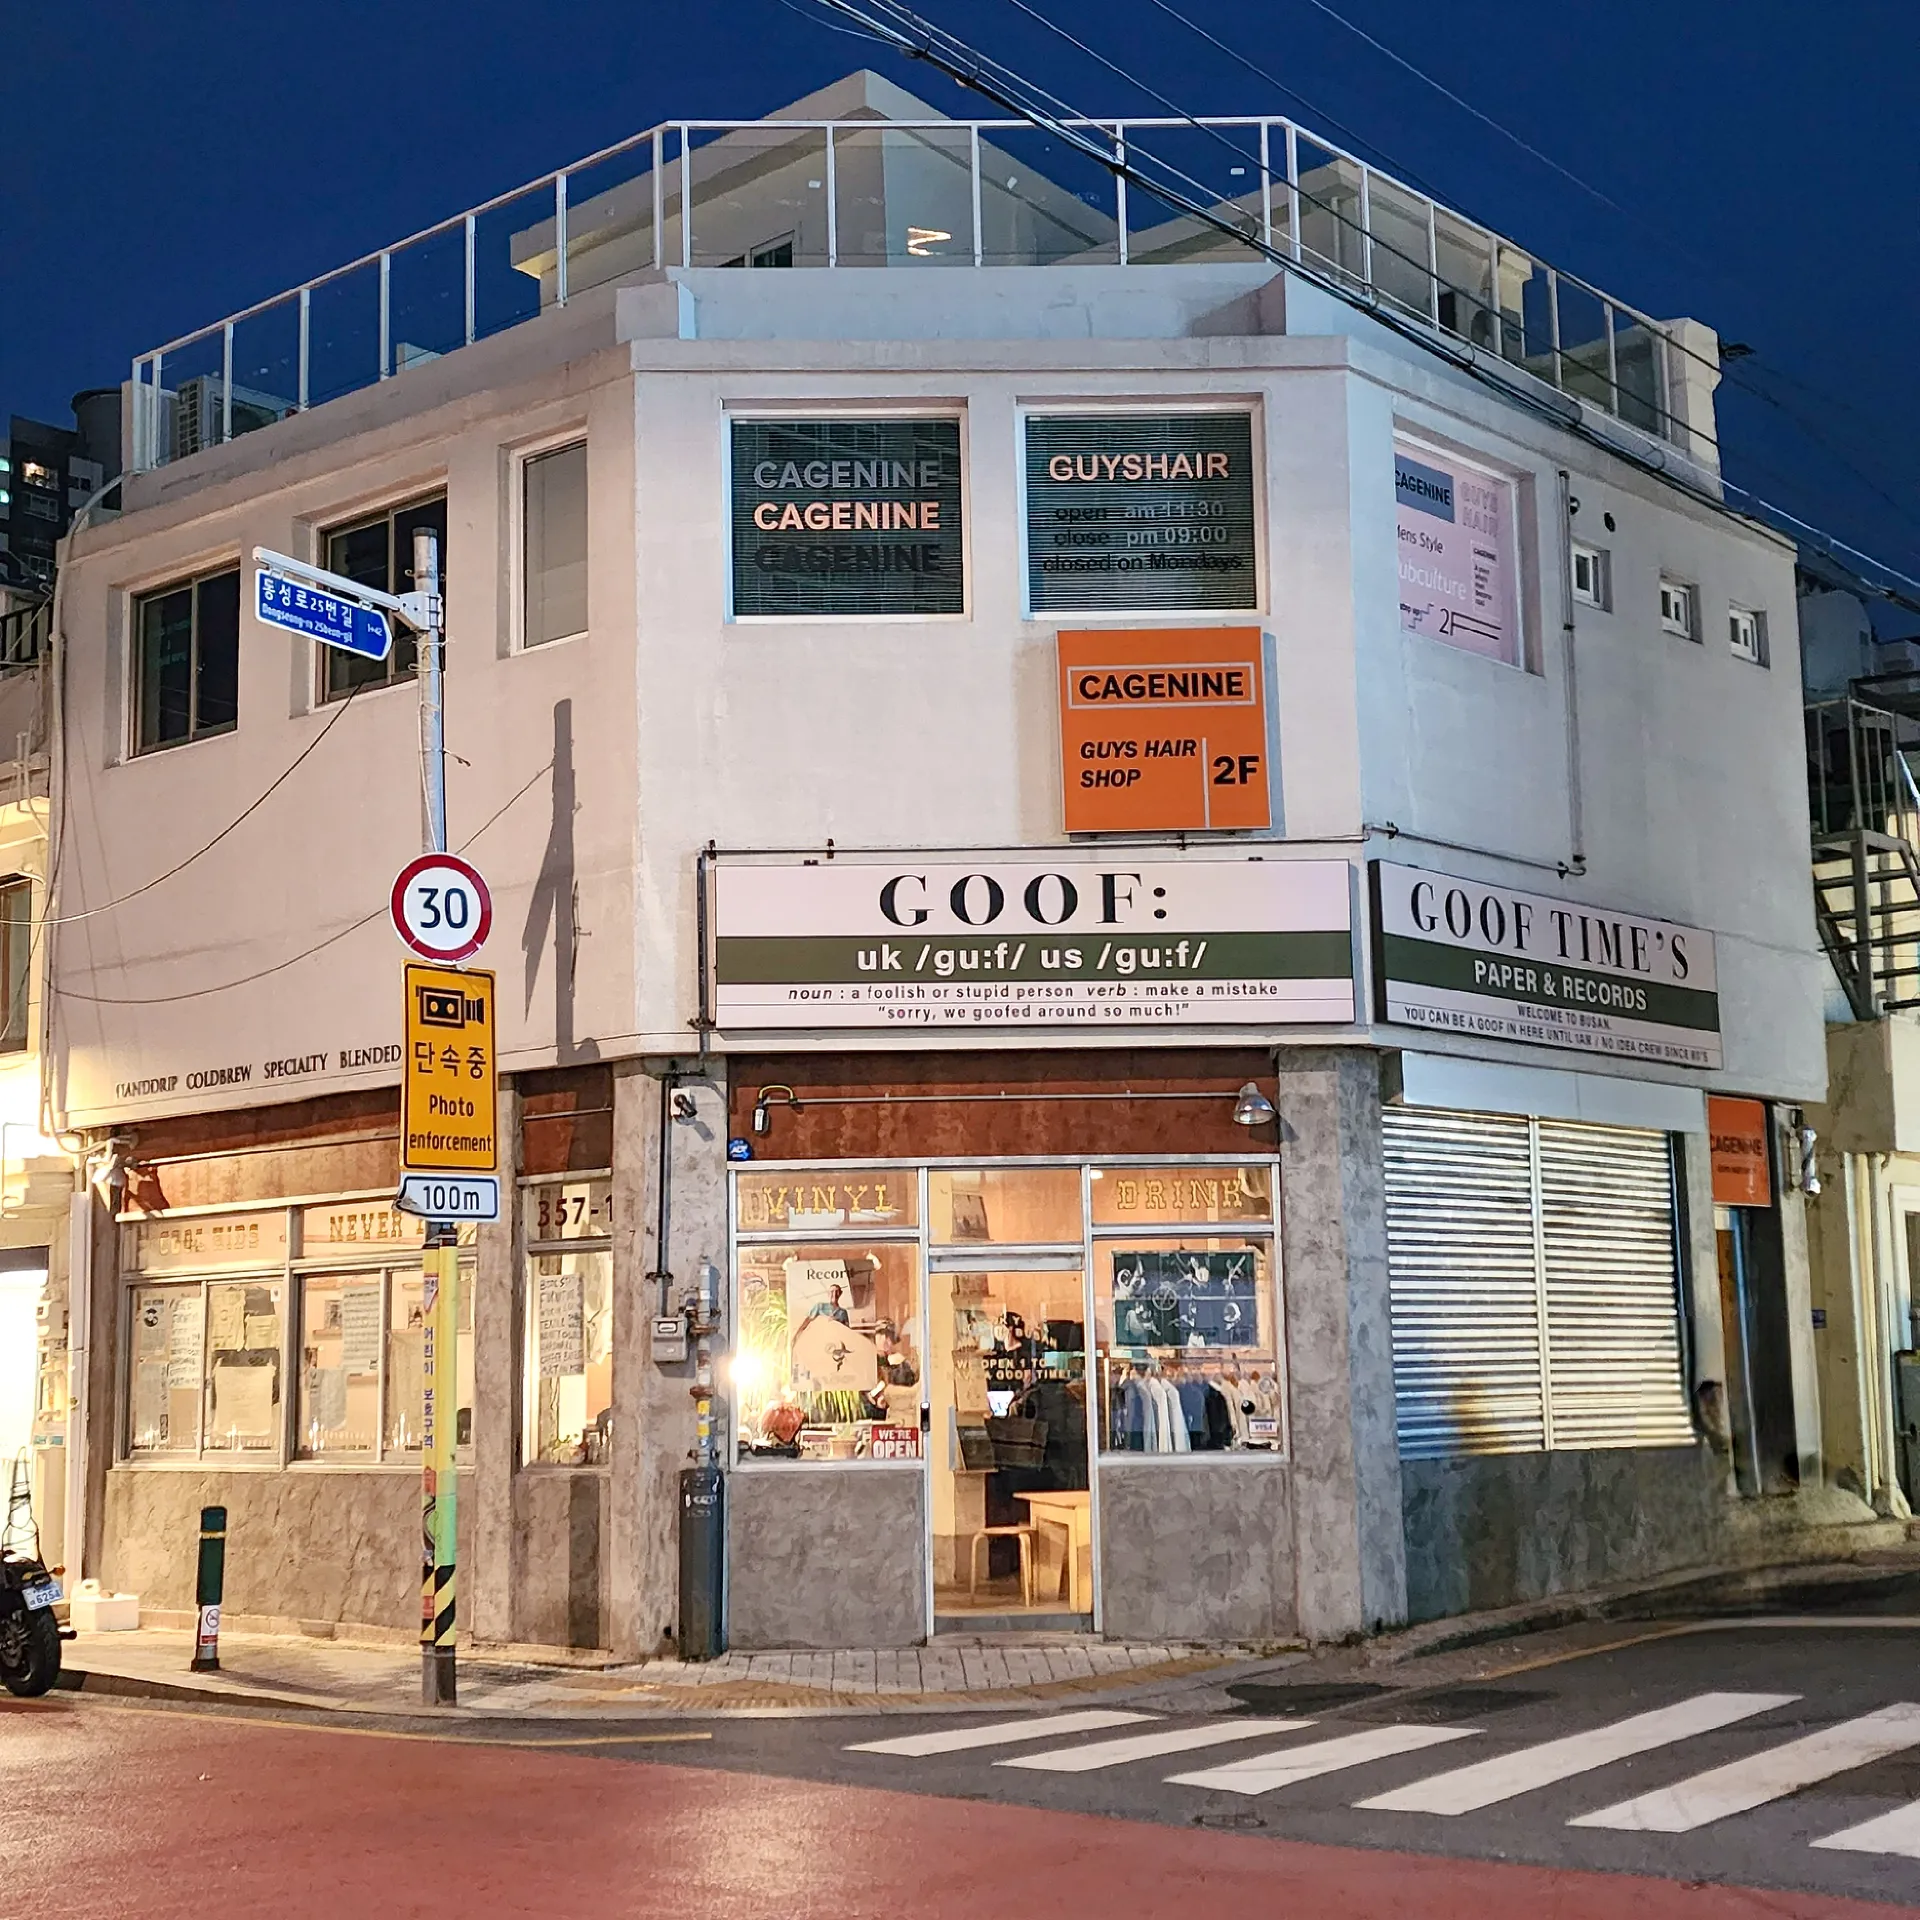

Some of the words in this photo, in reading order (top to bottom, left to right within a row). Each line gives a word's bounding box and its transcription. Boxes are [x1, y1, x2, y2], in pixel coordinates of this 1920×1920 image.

[753, 460, 940, 489] CAGENINE
[1049, 452, 1229, 481] GUYSHAIR
[753, 502, 940, 530] CAGENINE
[1055, 505, 1107, 524] open
[1054, 530, 1110, 546] close
[1126, 530, 1158, 548] pm
[1165, 526, 1227, 544] 09:00
[1420, 532, 1443, 553] Style
[754, 544, 941, 572] CAGENINE
[1043, 554, 1111, 571] closed
[1118, 556, 1143, 571] on
[1150, 552, 1243, 573] Mondays
[1399, 559, 1466, 600] ubculture
[262, 578, 353, 629] 동성로25번길
[1079, 672, 1244, 700] CAGENINE
[1080, 741, 1138, 759] GUYS
[1144, 739, 1197, 757] HAIR
[1080, 769, 1141, 788] SHOP
[1213, 755, 1260, 785] 2F
[418, 887, 469, 929] 30
[879, 873, 1168, 927] GOOF:
[1411, 881, 1534, 951] GOOF
[1551, 910, 1689, 980] TIME'S
[857, 942, 902, 970] uk
[1041, 943, 1083, 969] us
[788, 988, 832, 999] noun
[851, 989, 860, 999] a
[868, 985, 925, 998] foolish
[932, 989, 949, 998] or
[956, 984, 1009, 1001] stupid
[1017, 986, 1073, 1000] person
[1087, 983, 1127, 996] verb
[1146, 983, 1189, 996] make
[1196, 986, 1204, 996] a
[1212, 982, 1278, 996] mistake
[1474, 959, 1538, 993] PAPER
[1543, 971, 1557, 997] &
[1562, 978, 1648, 1011] RECORDS
[944, 1008, 966, 1018] we
[973, 1005, 1031, 1021] goofed
[1038, 1005, 1096, 1017] around
[1104, 1007, 1122, 1017] so
[1517, 1004, 1562, 1024] WELCOME
[1566, 1012, 1577, 1025] TO
[1404, 1006, 1426, 1021] YOU
[1429, 1010, 1450, 1025] CAN
[1452, 1014, 1465, 1028] BE
[1468, 1016, 1475, 1029] A
[1478, 1018, 1504, 1032] GOOF
[1507, 1023, 1517, 1035] IN
[1520, 1025, 1543, 1039] HERE
[1547, 1029, 1573, 1044] UNTIL
[1602, 1036, 1613, 1050] NO
[186, 1065, 252, 1090] COLDBREW
[264, 1053, 328, 1079] SPECIALTY
[339, 1044, 402, 1069] BLENDED
[415, 1042, 487, 1080] 단속중
[429, 1094, 475, 1117] Photo
[409, 1131, 492, 1152] enforcement
[423, 1185, 480, 1210] 100m
[763, 1184, 894, 1215] VINYL
[1117, 1178, 1243, 1209] DRINK
[330, 1211, 403, 1242] NEVER
[981, 1358, 1015, 1369] OPEN
[878, 1429, 912, 1440] WE'RE
[873, 1440, 917, 1459] OPEN
